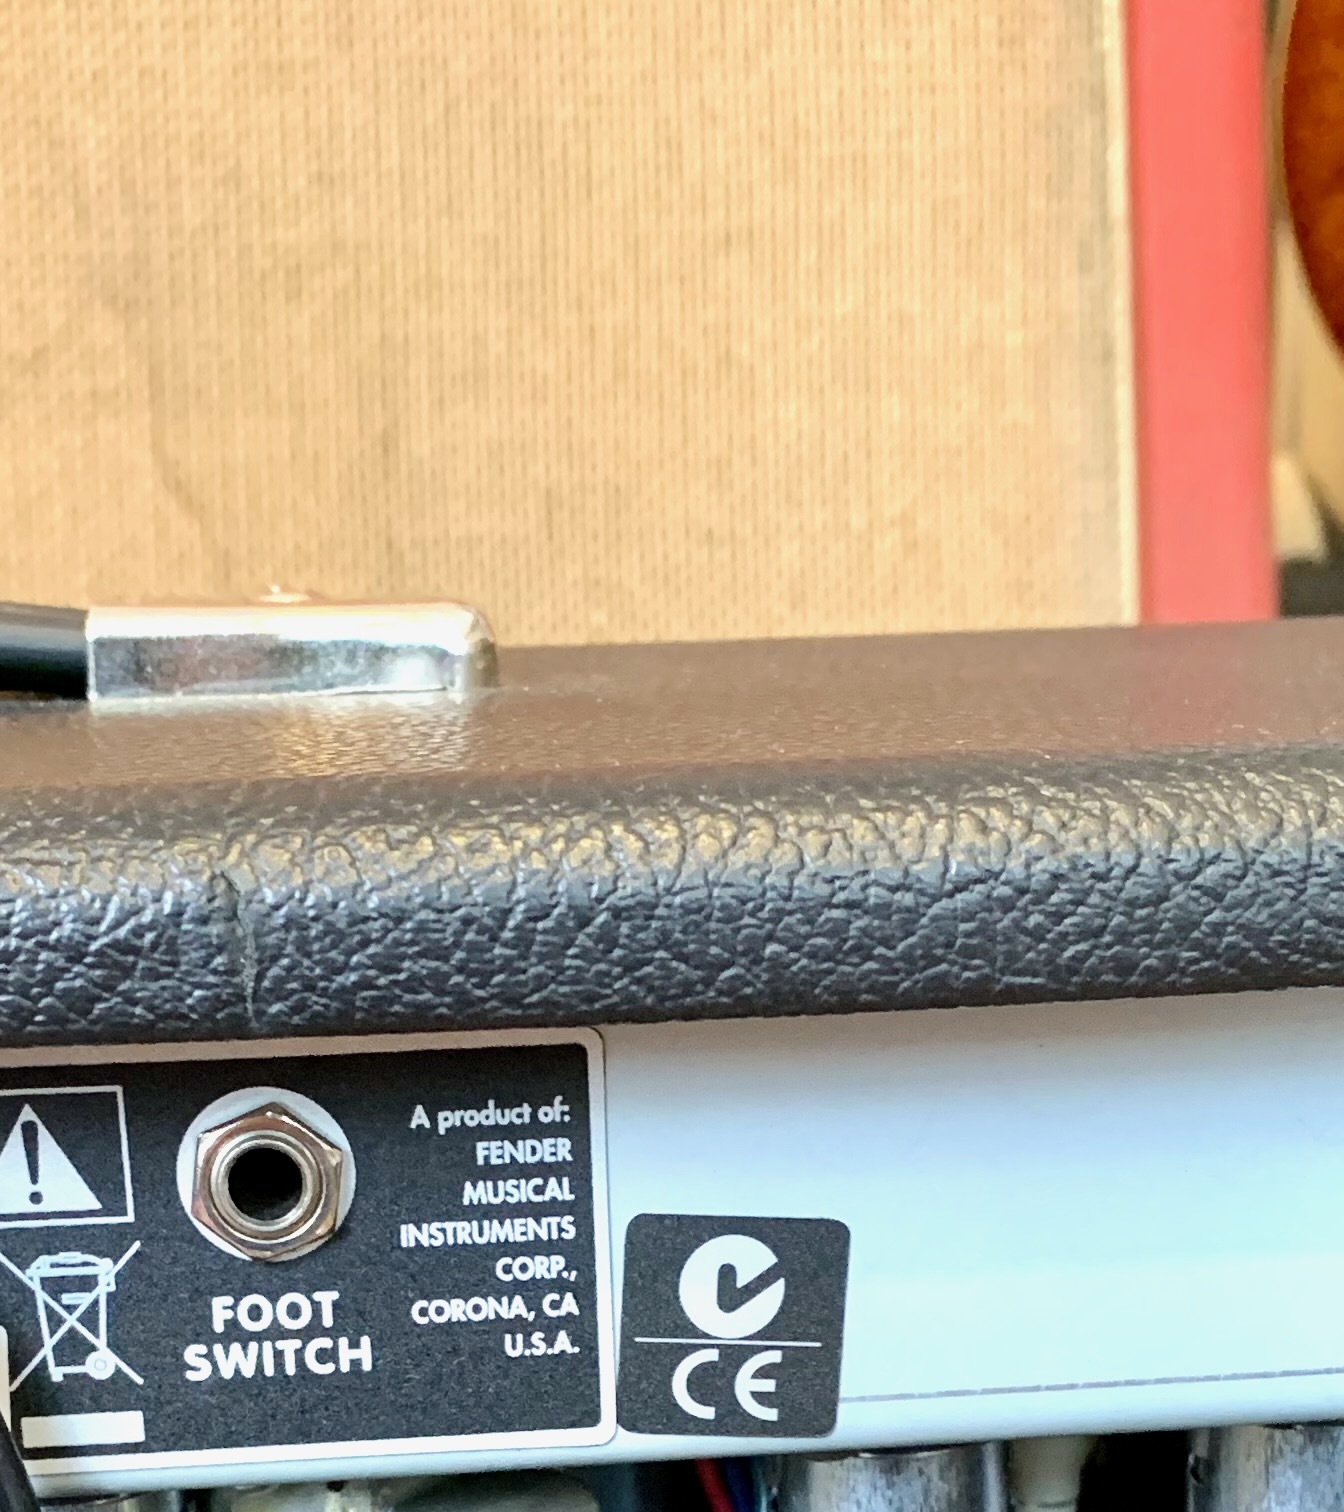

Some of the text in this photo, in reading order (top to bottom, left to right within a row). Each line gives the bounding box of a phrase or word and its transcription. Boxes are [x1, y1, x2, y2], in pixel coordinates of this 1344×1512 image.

[410, 1104, 431, 1129] A
[437, 1099, 531, 1135] product
[475, 1137, 572, 1166] FENDER
[462, 1177, 575, 1206] MUSICAL
[399, 1216, 576, 1247] INSTRUMENTS
[212, 1291, 340, 1334] FOOT
[410, 1292, 579, 1326] CORONA, CA
[183, 1335, 373, 1382] SWITCH
[503, 1331, 580, 1358] U.S.A.
